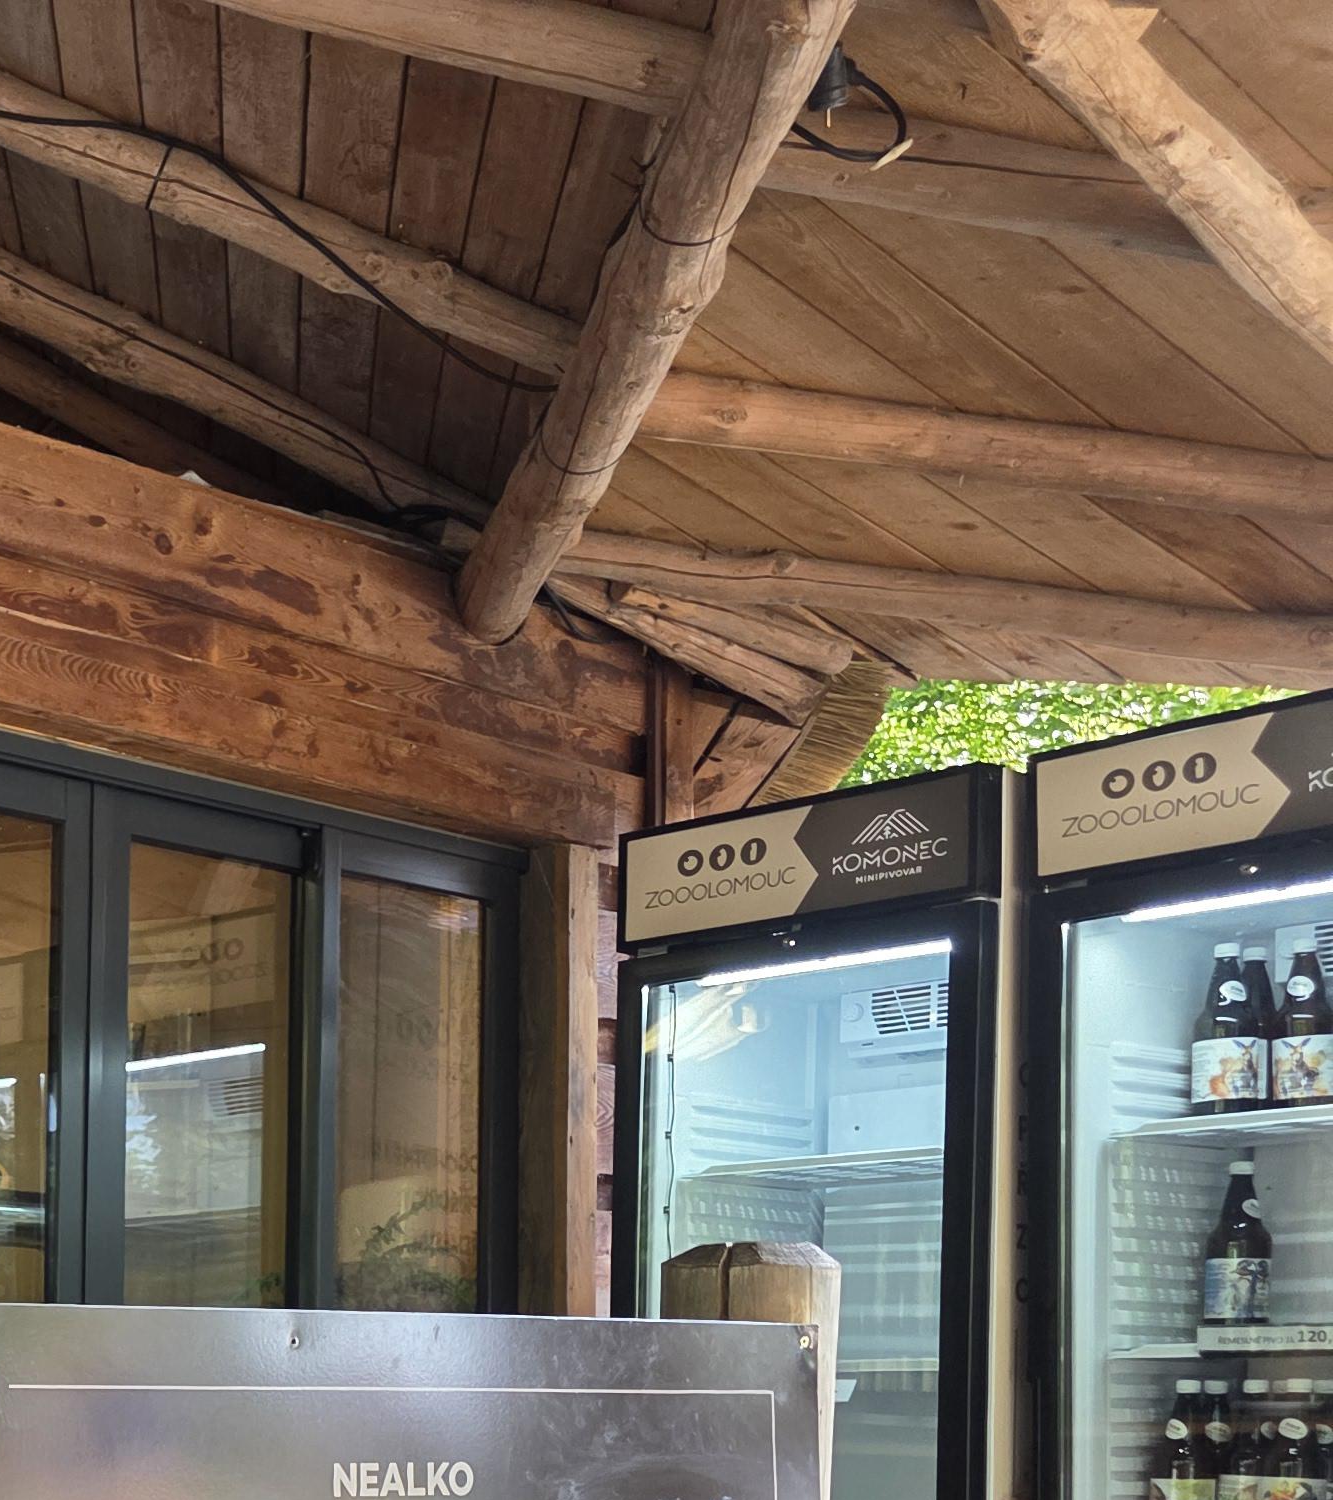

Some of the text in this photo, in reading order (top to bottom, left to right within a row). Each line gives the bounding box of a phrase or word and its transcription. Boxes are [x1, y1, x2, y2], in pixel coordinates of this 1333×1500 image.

[1062, 784, 1259, 838] ZOOOLOMOUC
[645, 867, 795, 909] ZOOOLOMOUC
[856, 866, 921, 884] MINIPIVOVAR
[333, 1462, 473, 1497] NEALKO
